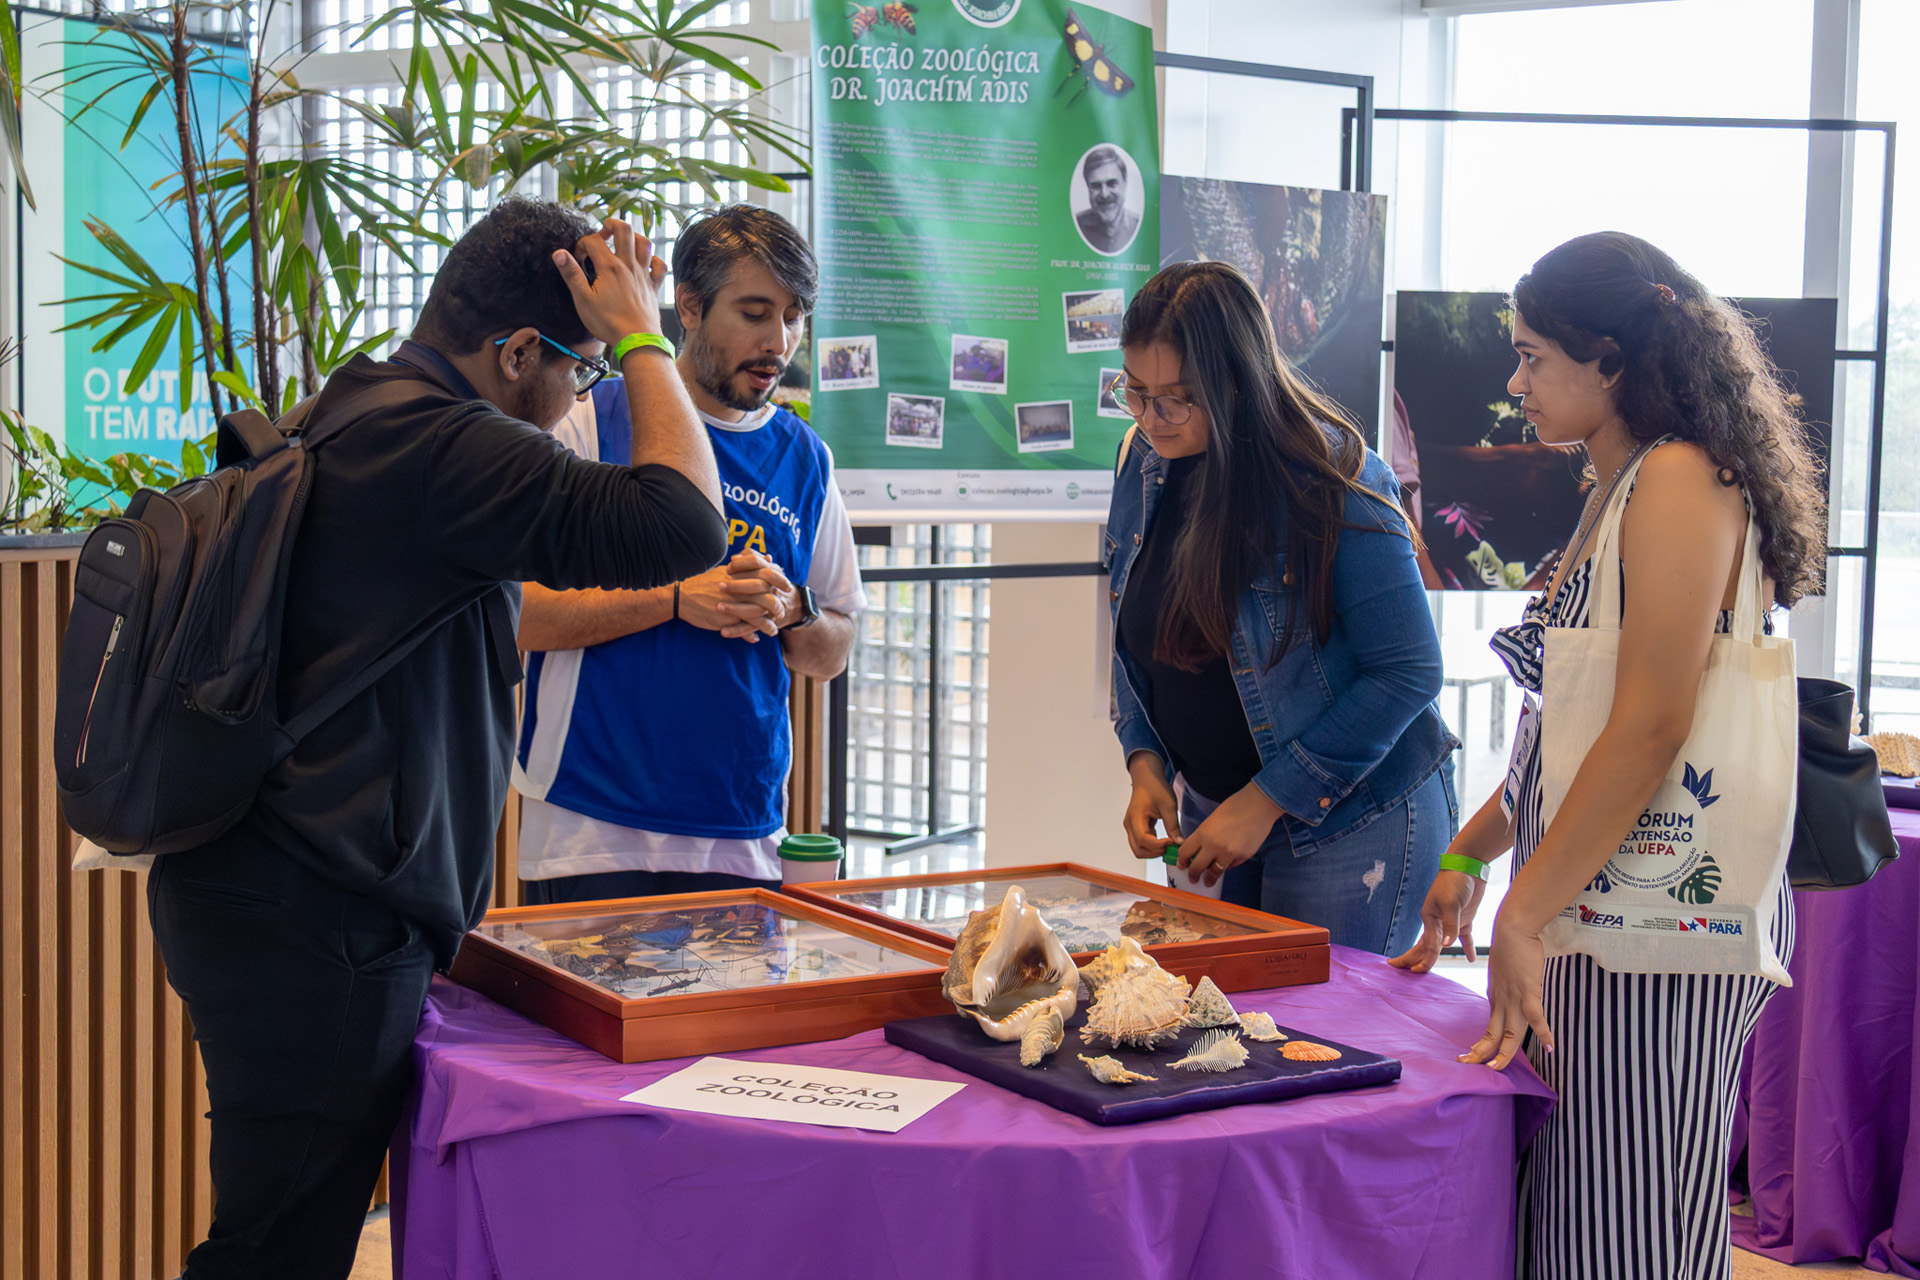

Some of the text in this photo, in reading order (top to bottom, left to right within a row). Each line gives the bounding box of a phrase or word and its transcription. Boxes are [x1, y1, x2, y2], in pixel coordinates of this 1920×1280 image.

[817, 44, 1040, 79] COLEÇÃO ZOOLÓGICA
[830, 75, 1029, 106] DR. JOACHIM ADIS
[84, 368, 243, 403] O FUTU
[84, 406, 149, 440] TEM
[723, 517, 767, 554] PA
[1637, 808, 1694, 828] ÓRUM
[1618, 842, 1676, 856] DA UEPA
[1581, 910, 1624, 926] UEPA
[695, 1083, 901, 1113] ZOOLÓGICA
[732, 1075, 898, 1100] COLEÇÃO
